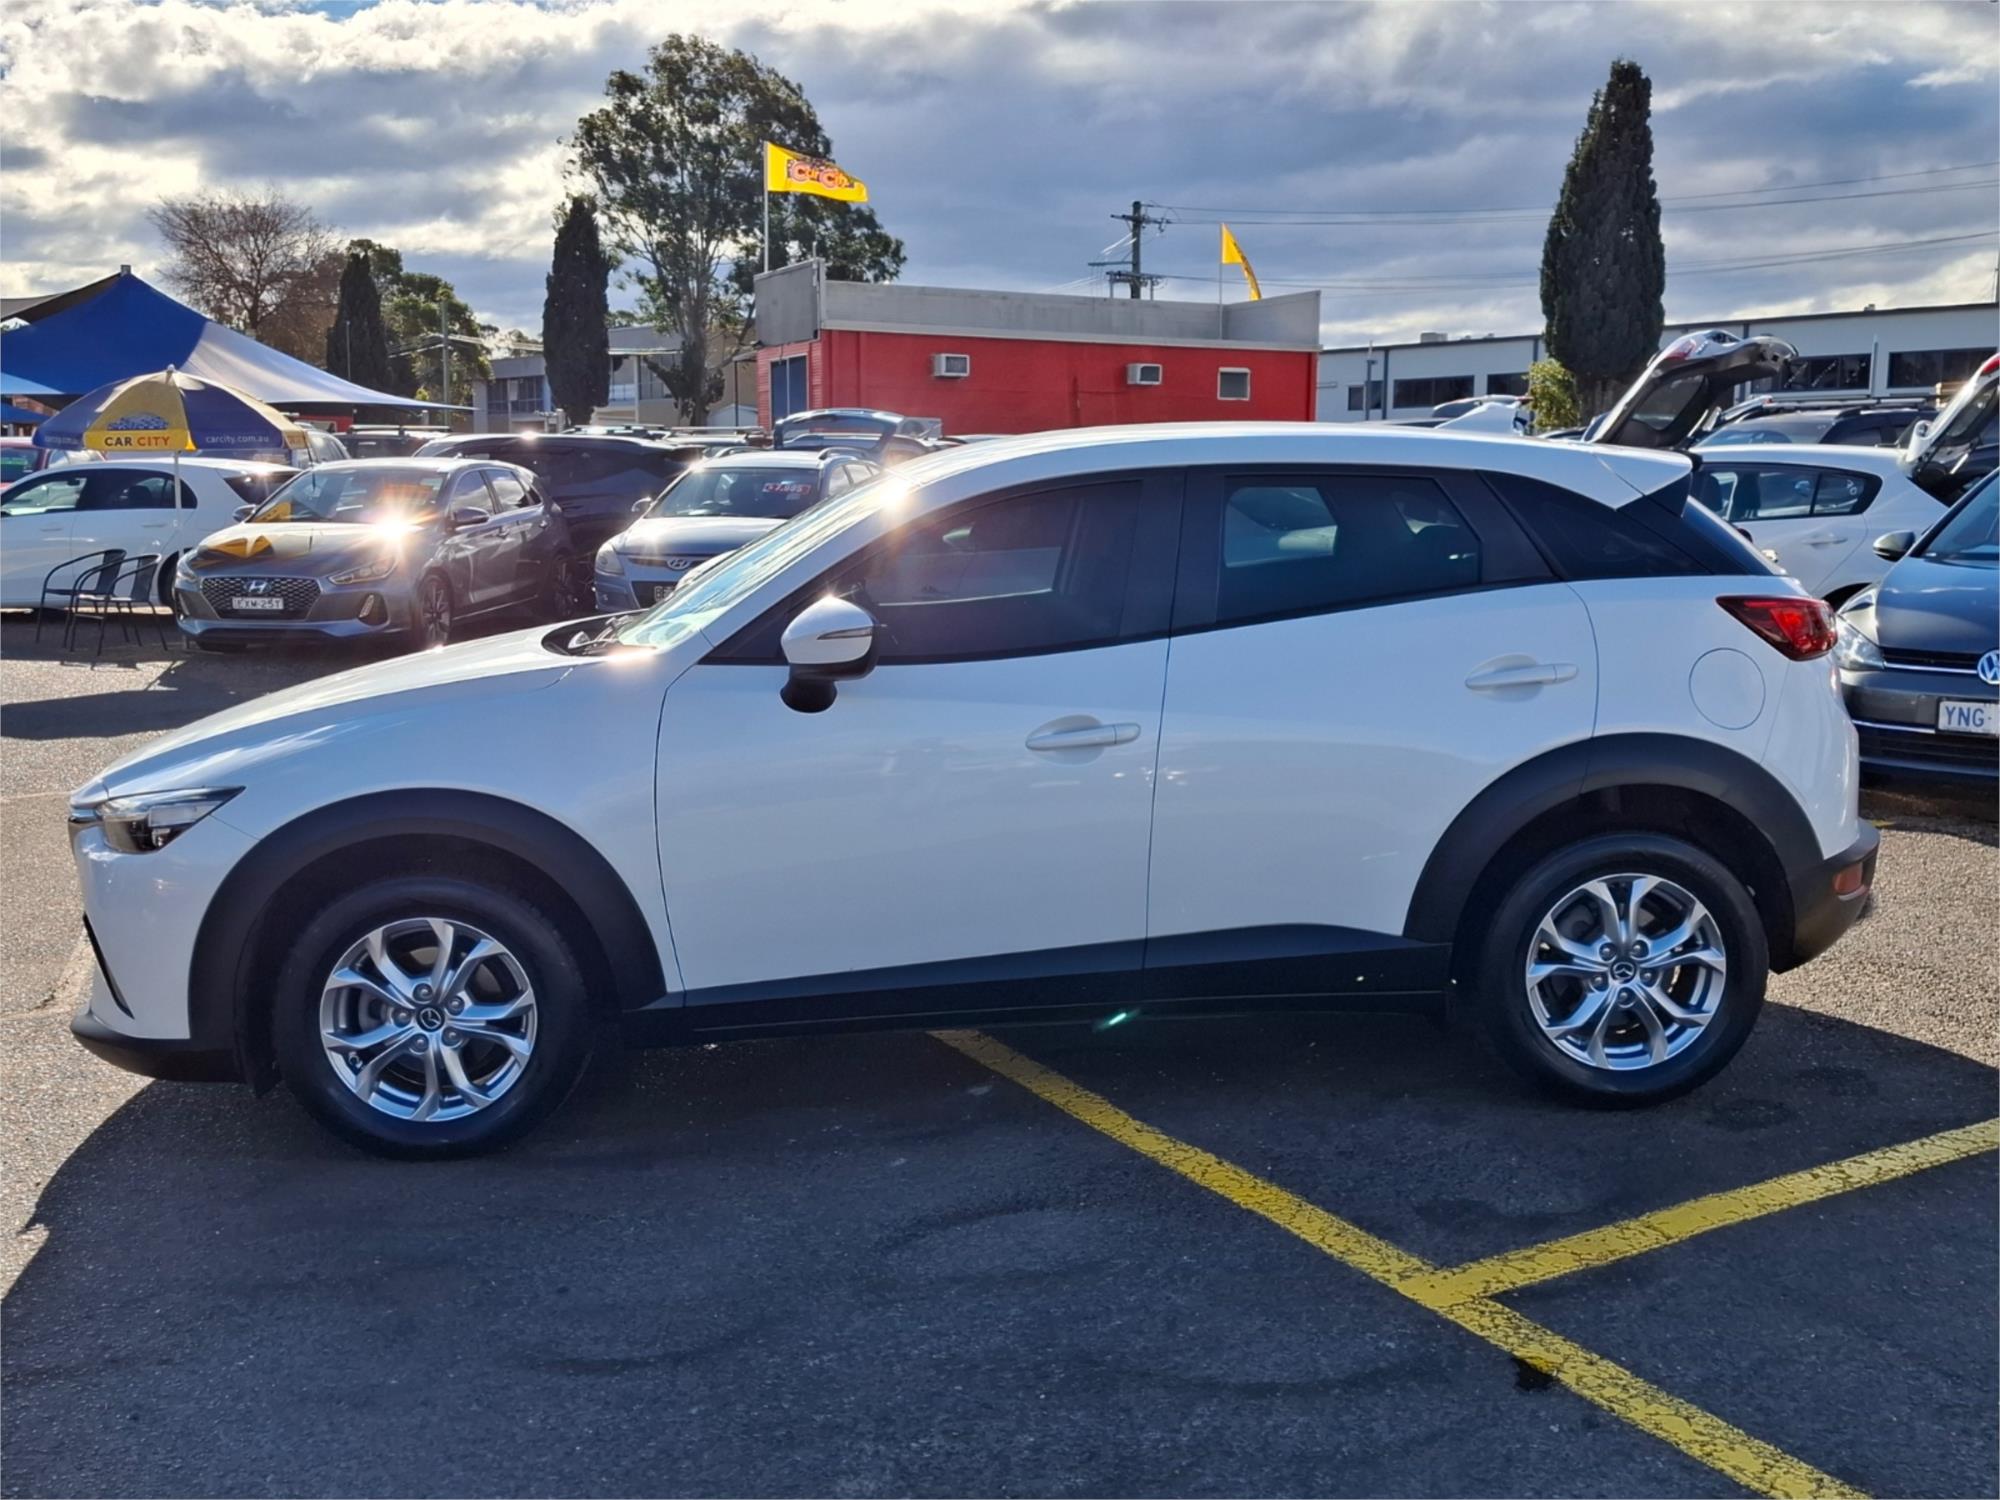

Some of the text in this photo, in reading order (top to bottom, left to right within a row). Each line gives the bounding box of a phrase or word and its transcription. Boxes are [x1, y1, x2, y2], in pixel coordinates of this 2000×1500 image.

[104, 436, 170, 446] CAR CITY
[205, 434, 269, 444] carcity.com.au
